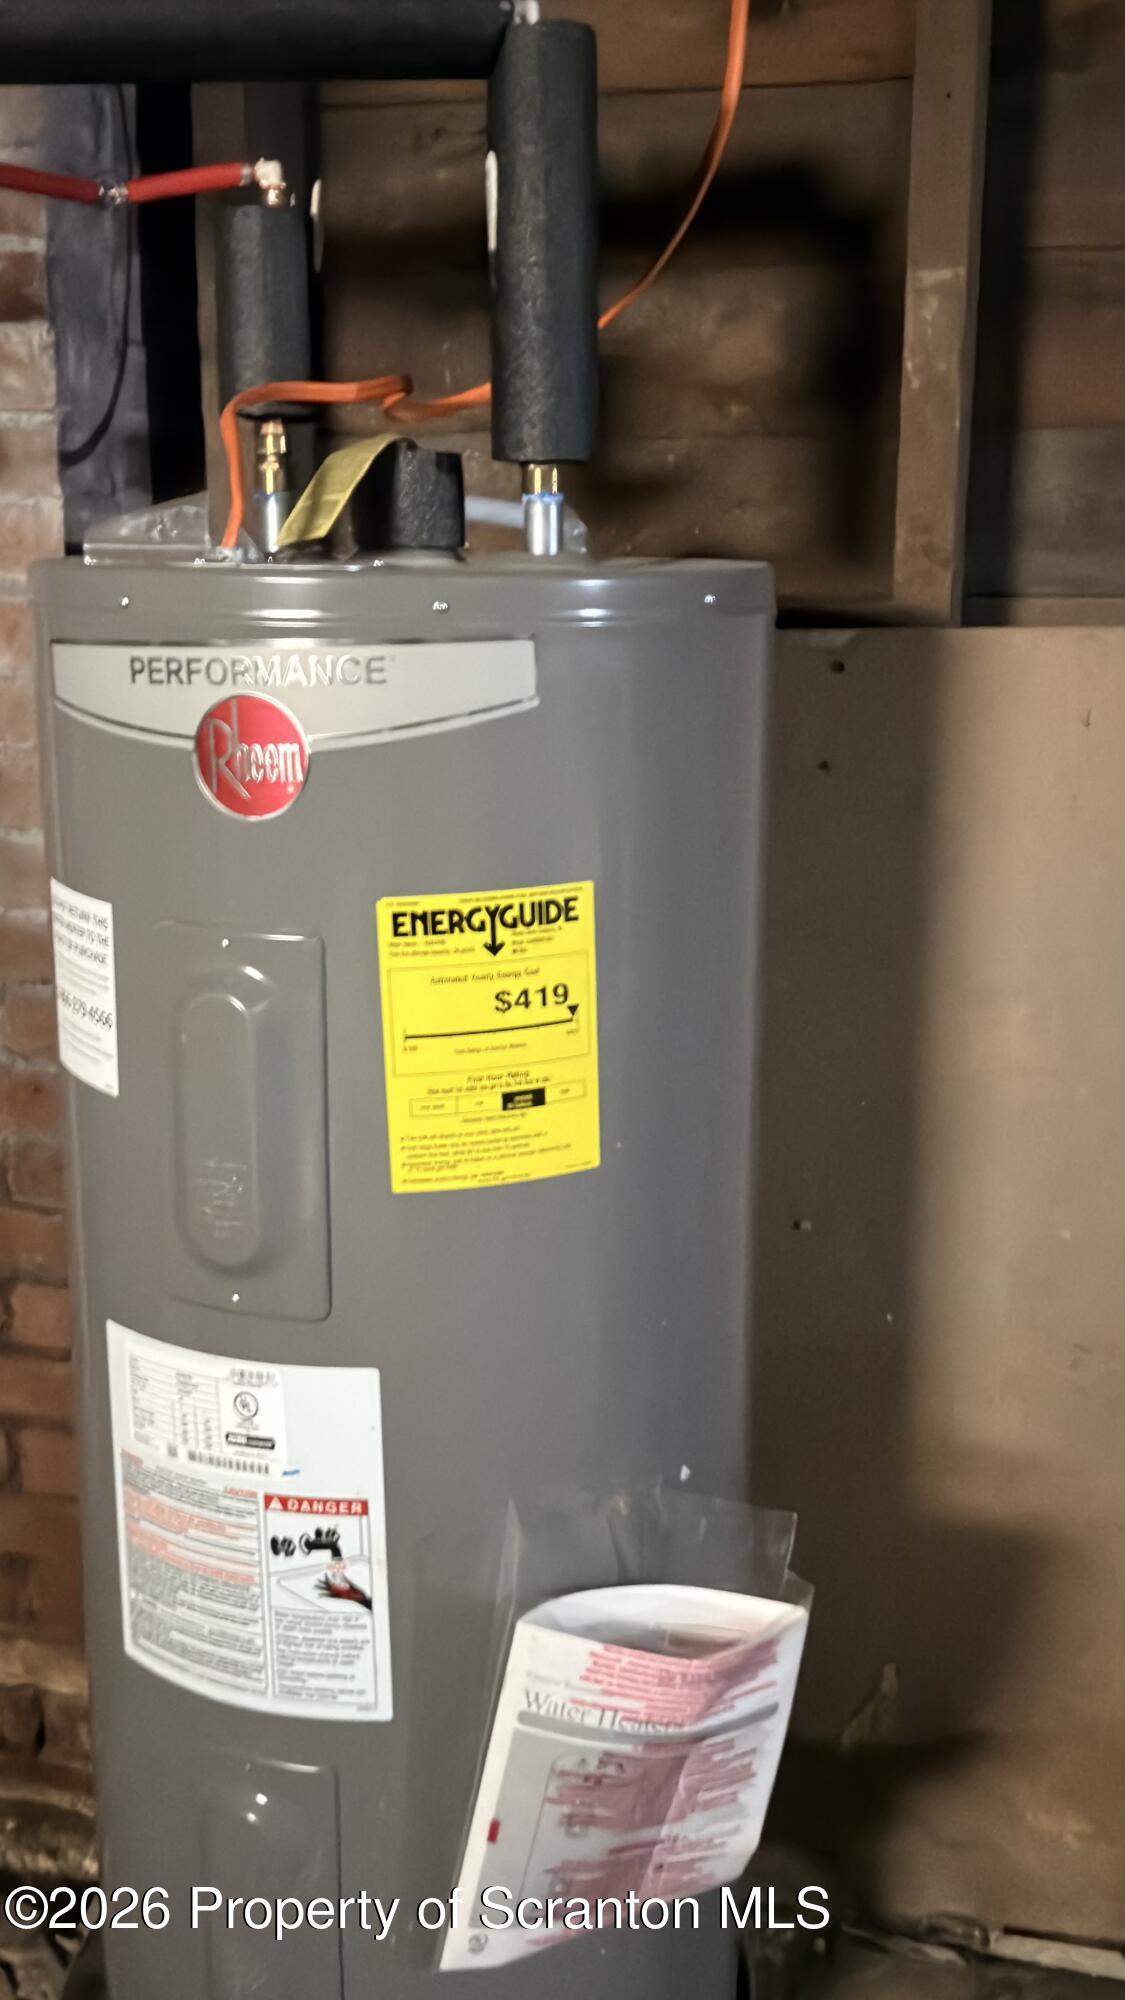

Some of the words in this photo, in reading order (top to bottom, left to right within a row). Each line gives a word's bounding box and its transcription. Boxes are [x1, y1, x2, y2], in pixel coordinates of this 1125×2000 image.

[130, 655, 388, 687] PERFORMANCE
[206, 699, 304, 799] Rheem
[391, 896, 579, 938] ENERGYGUIDE
[494, 982, 569, 1014] $419
[287, 1498, 362, 1514] DANGER
